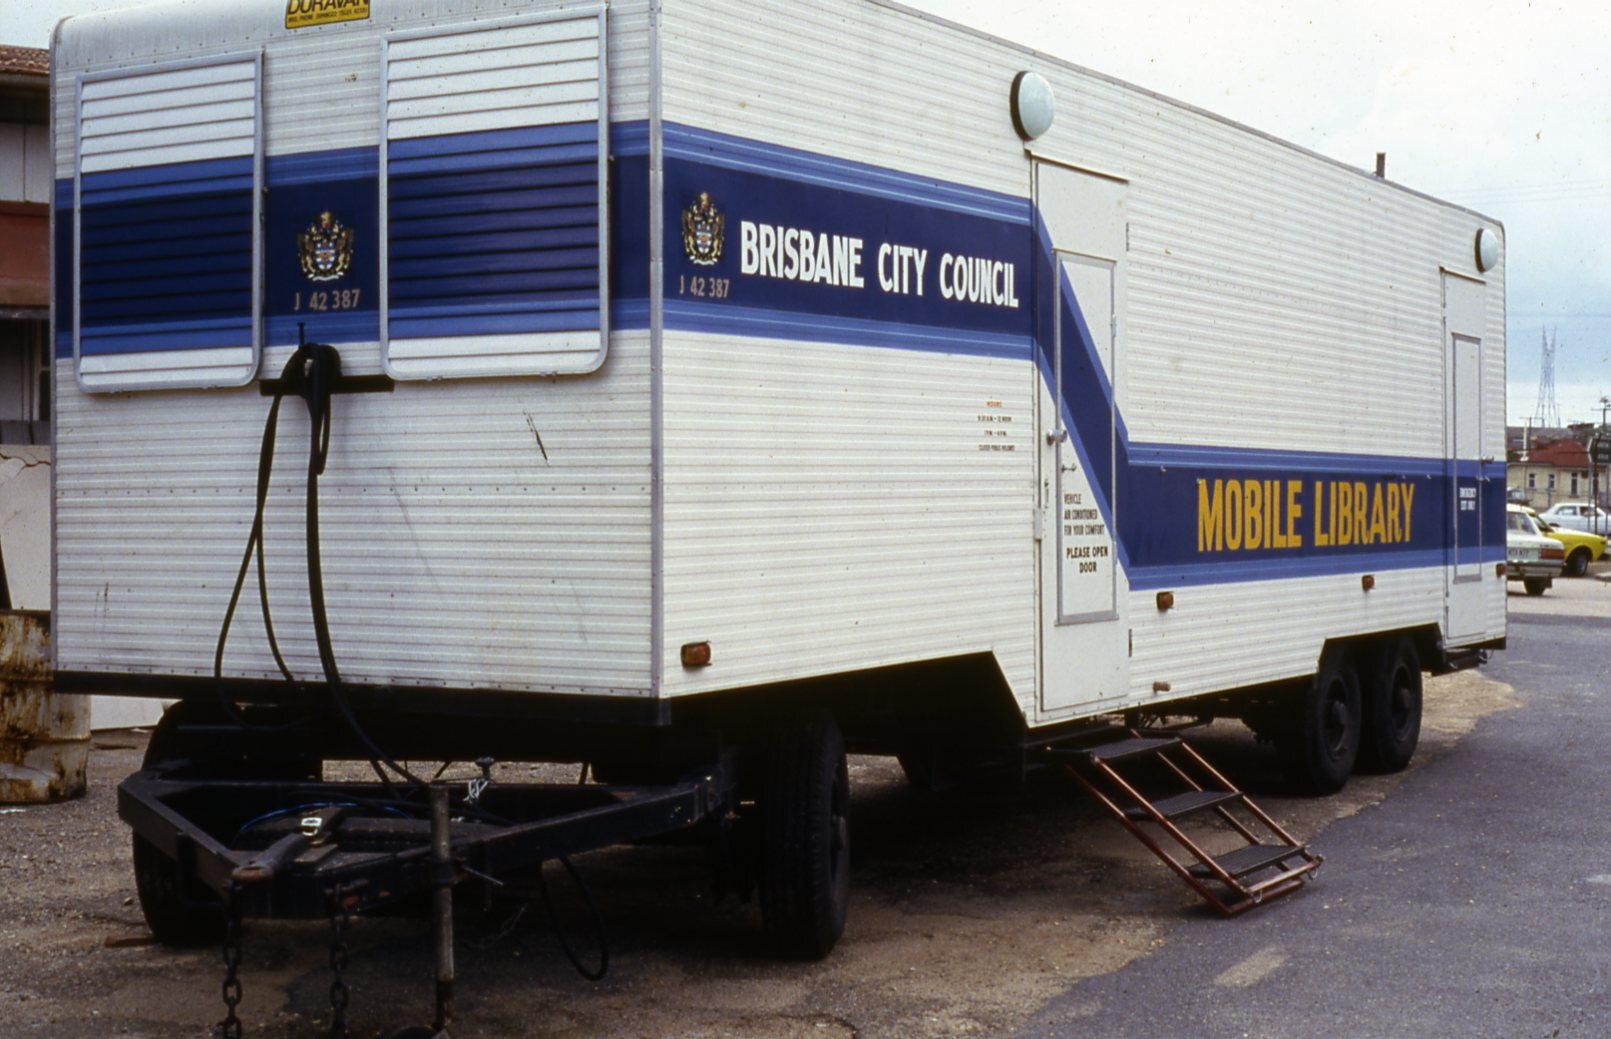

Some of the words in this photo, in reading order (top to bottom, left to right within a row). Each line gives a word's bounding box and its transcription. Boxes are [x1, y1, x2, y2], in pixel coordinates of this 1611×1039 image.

[288, 0, 369, 14] DURAV
[740, 219, 865, 289] BRISBANE
[877, 242, 928, 296] CITY
[938, 252, 1019, 309] COUNCIL
[679, 275, 685, 295] J
[690, 276, 706, 297] 42
[708, 278, 731, 299] 387
[293, 292, 301, 312] J
[309, 291, 328, 311] 42
[332, 288, 361, 310] 387
[1064, 493, 1082, 505] VEHICLE
[1072, 509, 1098, 520] CONDITIONED
[1198, 478, 1303, 552] MOBILE
[1314, 480, 1415, 546] LIBRARY
[1064, 525, 1072, 536] FOR
[1073, 525, 1084, 536] YOUR
[1085, 525, 1105, 536] COMFORT
[1066, 546, 1090, 559] PLEASE
[1092, 546, 1108, 557] OPEN
[1079, 561, 1097, 574] DOOR
